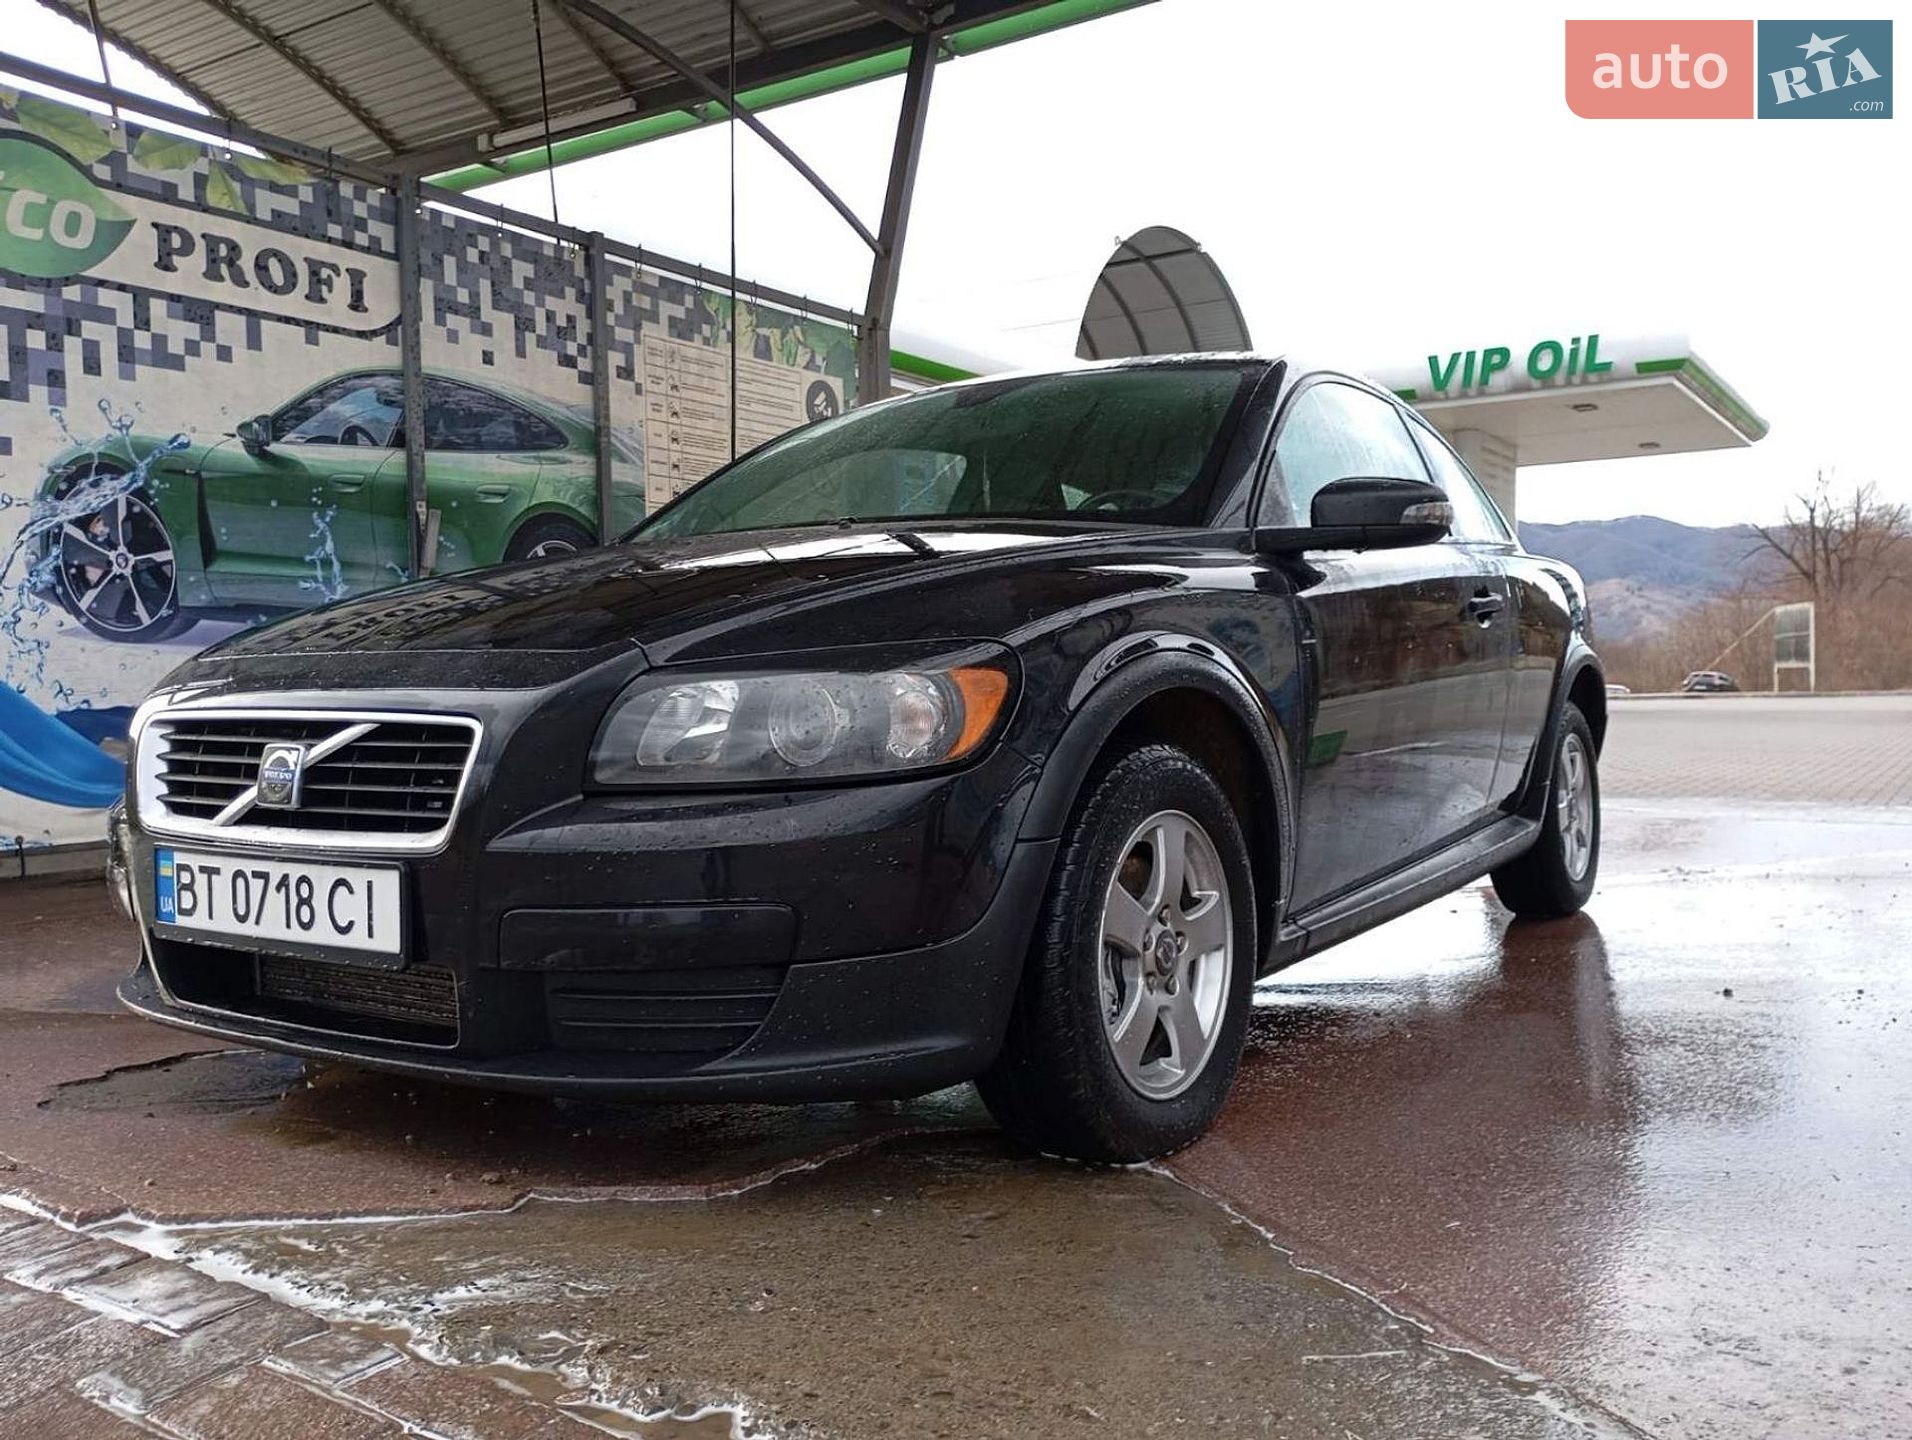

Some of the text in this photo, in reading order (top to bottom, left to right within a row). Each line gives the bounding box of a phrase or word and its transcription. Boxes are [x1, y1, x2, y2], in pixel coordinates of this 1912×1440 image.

[151, 221, 369, 313] PROFI
[1428, 346, 1511, 392] VIP
[160, 896, 175, 914] UA
[175, 862, 374, 939] BT 0718 CI
